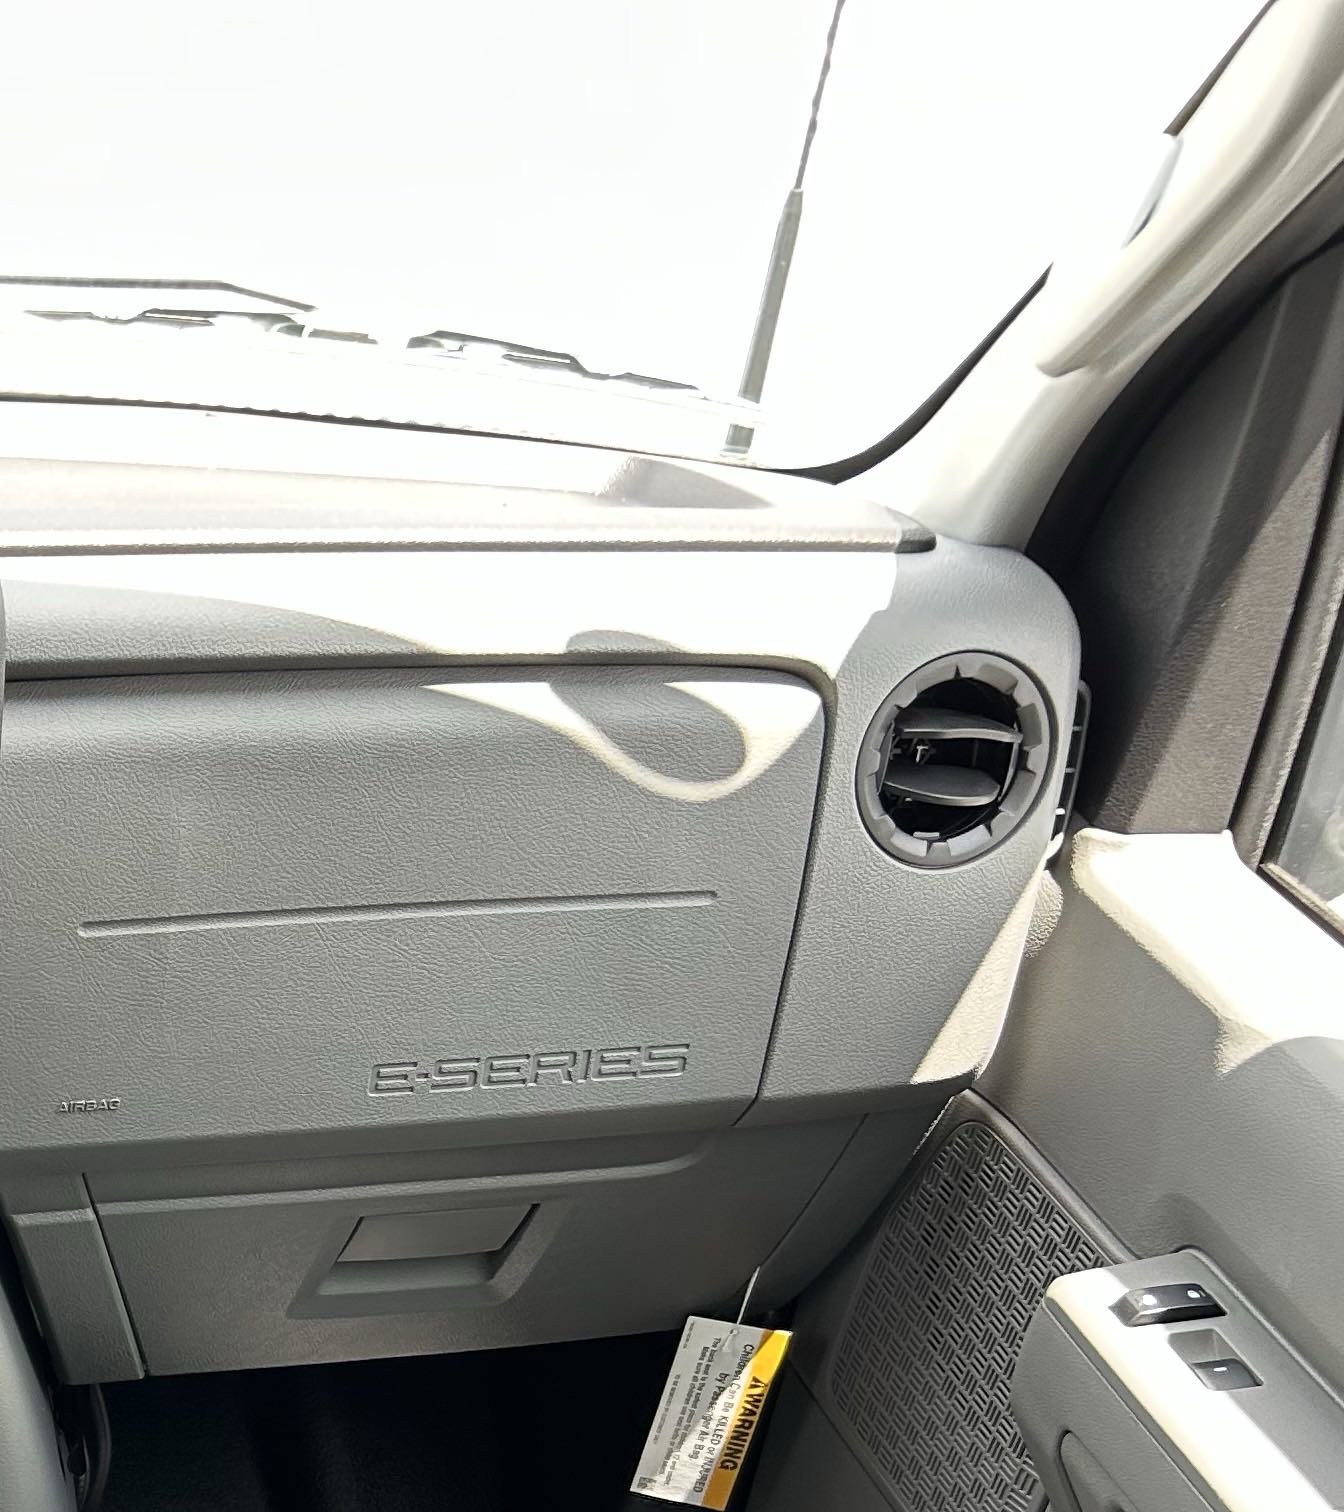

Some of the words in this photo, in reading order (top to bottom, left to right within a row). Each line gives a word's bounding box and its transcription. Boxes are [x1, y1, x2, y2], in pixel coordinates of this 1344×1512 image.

[367, 1043, 690, 1097] E-SERIES
[60, 1099, 121, 1113] AIRBAG
[716, 1372, 729, 1383] by
[733, 1345, 755, 1382] Children
[697, 1431, 709, 1441] Air
[710, 1416, 729, 1445] KILLED
[719, 1391, 765, 1471] WARNING
[693, 1457, 714, 1492] INJURED
